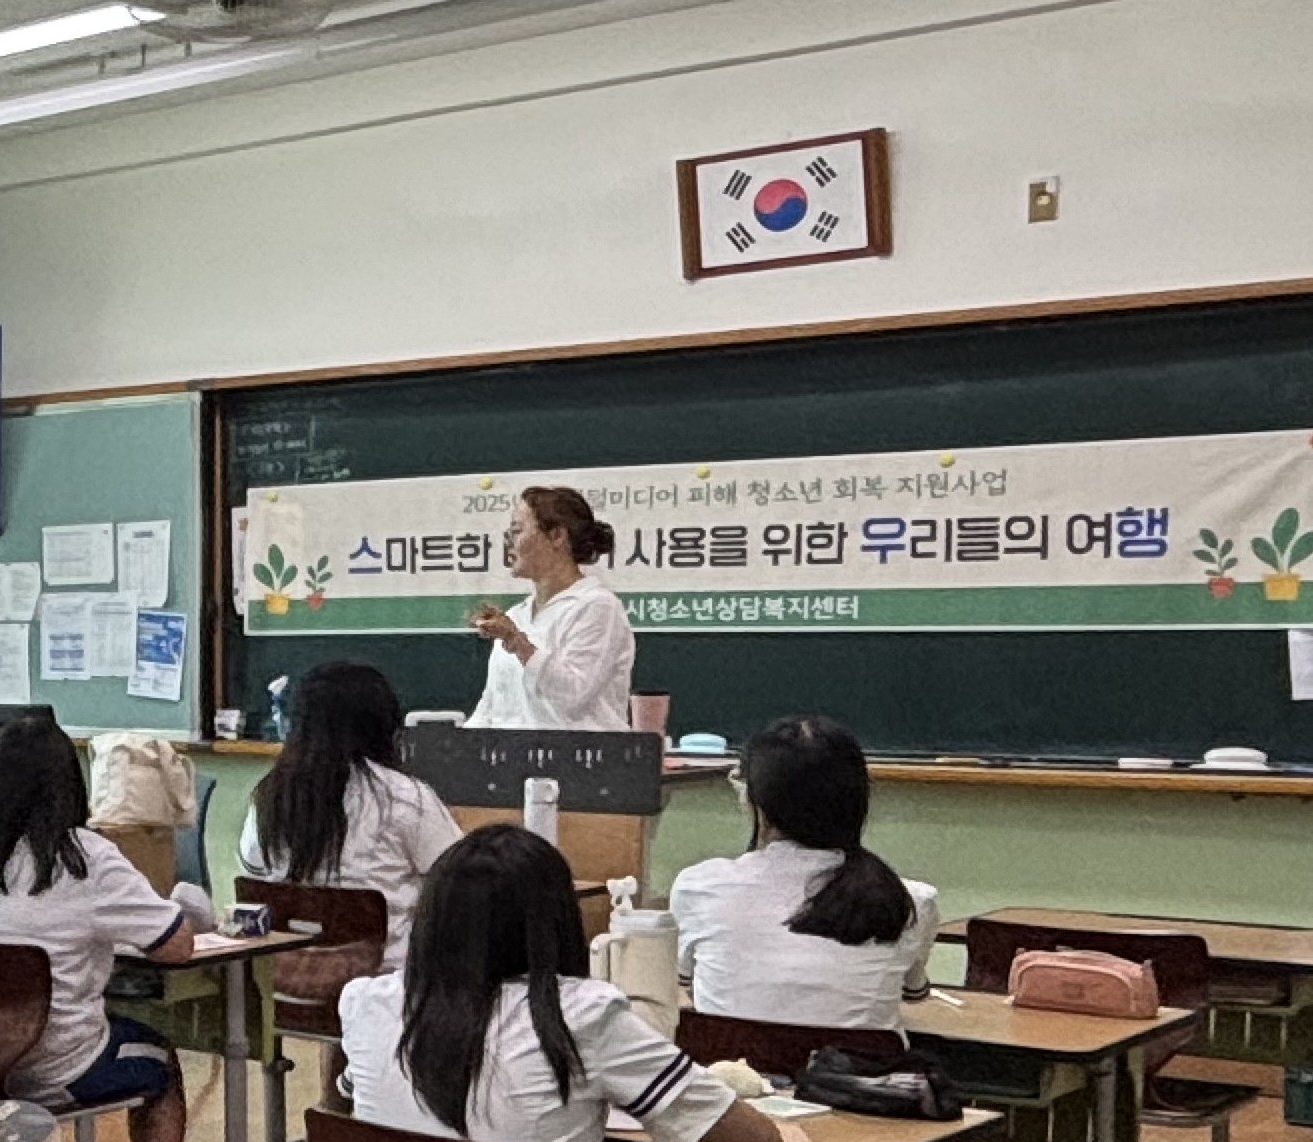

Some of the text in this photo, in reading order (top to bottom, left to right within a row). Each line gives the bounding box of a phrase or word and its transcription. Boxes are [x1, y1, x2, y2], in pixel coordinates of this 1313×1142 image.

[463, 470, 1008, 515] 2025 털미디어 피해 청소년 회복 지원사업
[348, 533, 493, 574] 스마트한
[625, 526, 748, 569] 사용을
[762, 521, 848, 566] 위한
[860, 515, 1049, 564] 우리들의
[1066, 506, 1170, 560] 여행
[625, 595, 859, 621] 시청소년상담복지센터
